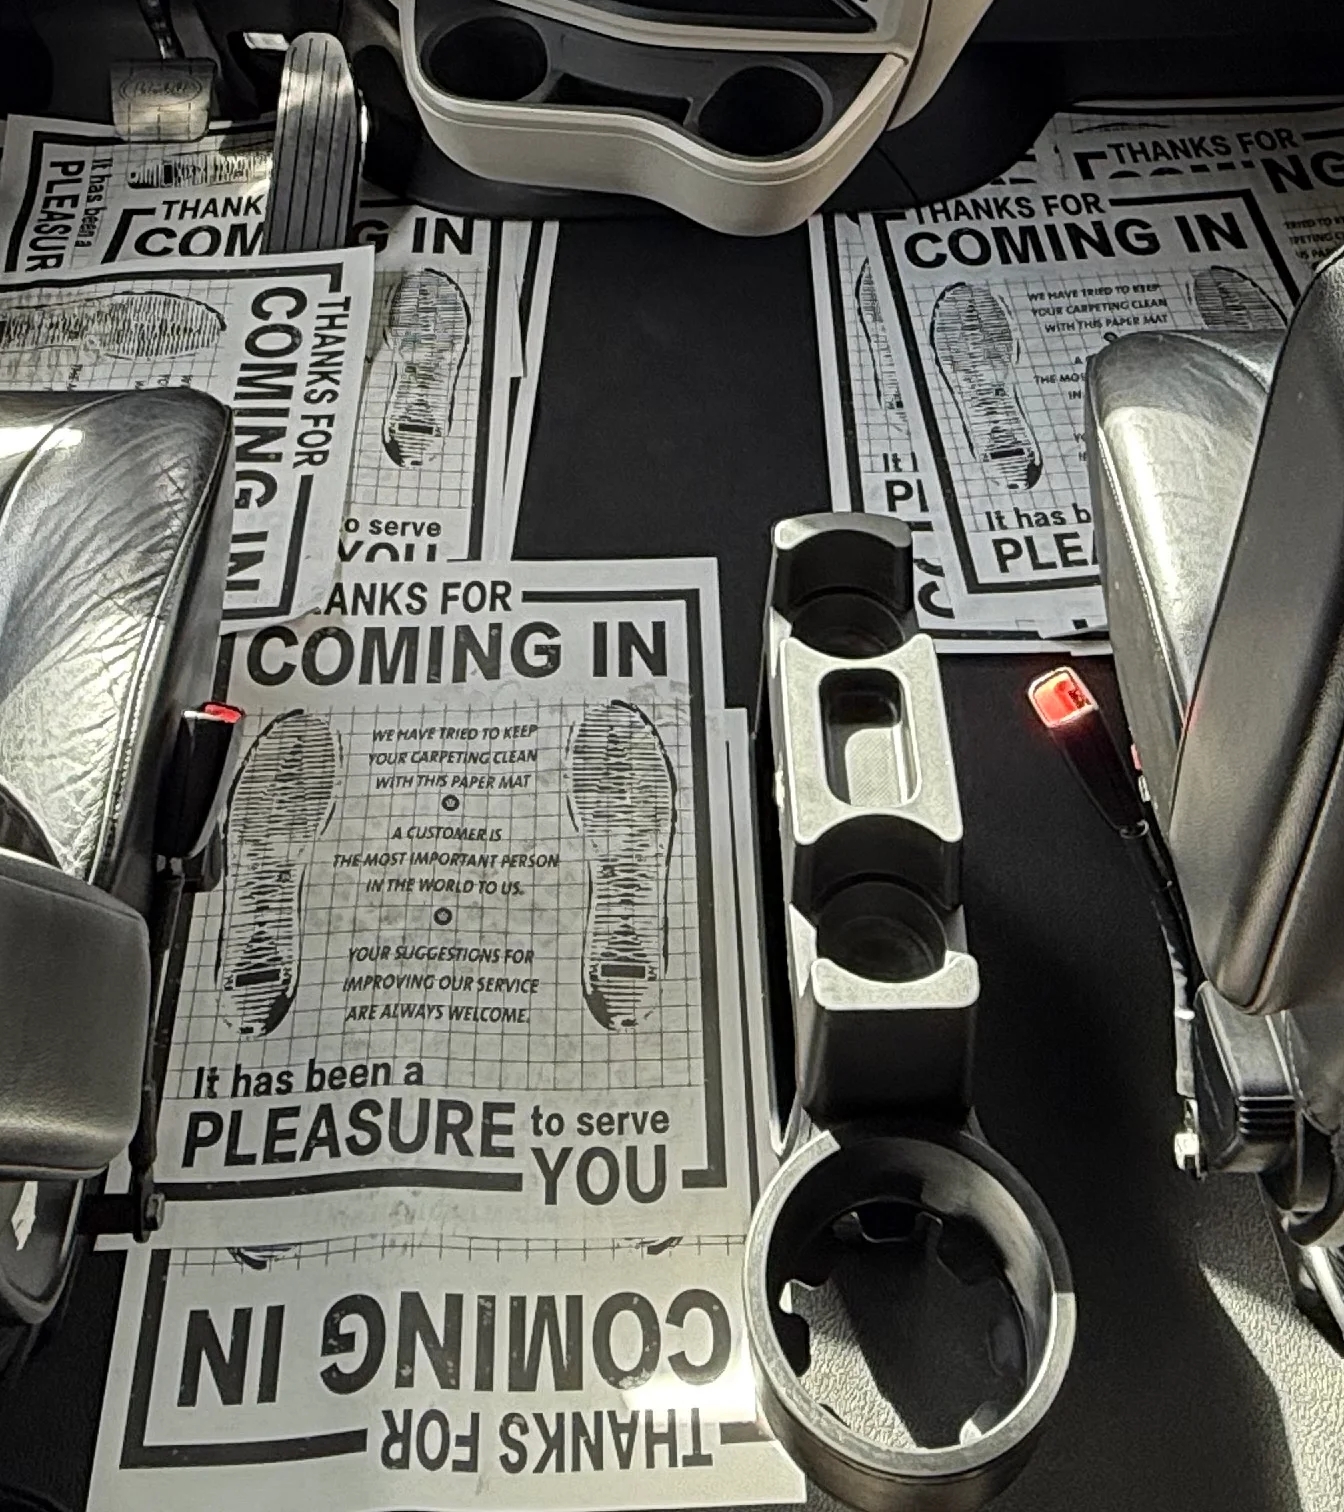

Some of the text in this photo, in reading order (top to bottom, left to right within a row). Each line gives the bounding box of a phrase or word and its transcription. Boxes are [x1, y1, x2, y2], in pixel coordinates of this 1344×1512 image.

[1108, 128, 1297, 164] THANKS FOR
[91, 157, 113, 171] It
[86, 173, 113, 205] has
[25, 160, 85, 272] PLEASUR
[161, 193, 265, 221] THANK
[913, 192, 1106, 225] THANKS FOR
[412, 217, 474, 255] IN
[903, 212, 1249, 269] COMING IN
[1028, 283, 1160, 302] WE HAVE TRIED TO KEEP
[1032, 298, 1168, 317] YOUR CARPETING CLEAN
[1045, 314, 1168, 333] WITH THIS PAPER MAT
[292, 296, 352, 470] THANKS FOR
[1033, 373, 1056, 384] THE
[1068, 390, 1082, 400] IN
[225, 286, 308, 592] COMING IN
[883, 452, 902, 472] It
[369, 519, 442, 536] serve
[985, 510, 1006, 531] It
[1013, 506, 1066, 529] has
[314, 579, 512, 616] ANKS FOR
[246, 621, 667, 687] COMING IN
[373, 724, 538, 742] WE HAVE TRIED TO KEEP
[369, 749, 538, 765] YOUR CARPETING CLEAN
[376, 774, 531, 789] WITH THIS PAPER MAT
[391, 826, 502, 841] A CUSTOMER IS
[333, 852, 560, 868] THE MOST IMPORTANT PERSON
[366, 879, 525, 896] IN THE WORLD TO US.
[349, 945, 535, 964] YOUR SUGGESTIONS FOR
[342, 974, 540, 994] IMPROVING OUR SERVICE
[345, 1003, 530, 1023] ARE ALWAYS WELCOME.
[195, 1058, 424, 1098] It has been a
[181, 1098, 670, 1169] PLEASURE to serve
[531, 1144, 667, 1207] YOU
[176, 1288, 733, 1408] COMING IN
[381, 1406, 714, 1475] THANKS FOR
